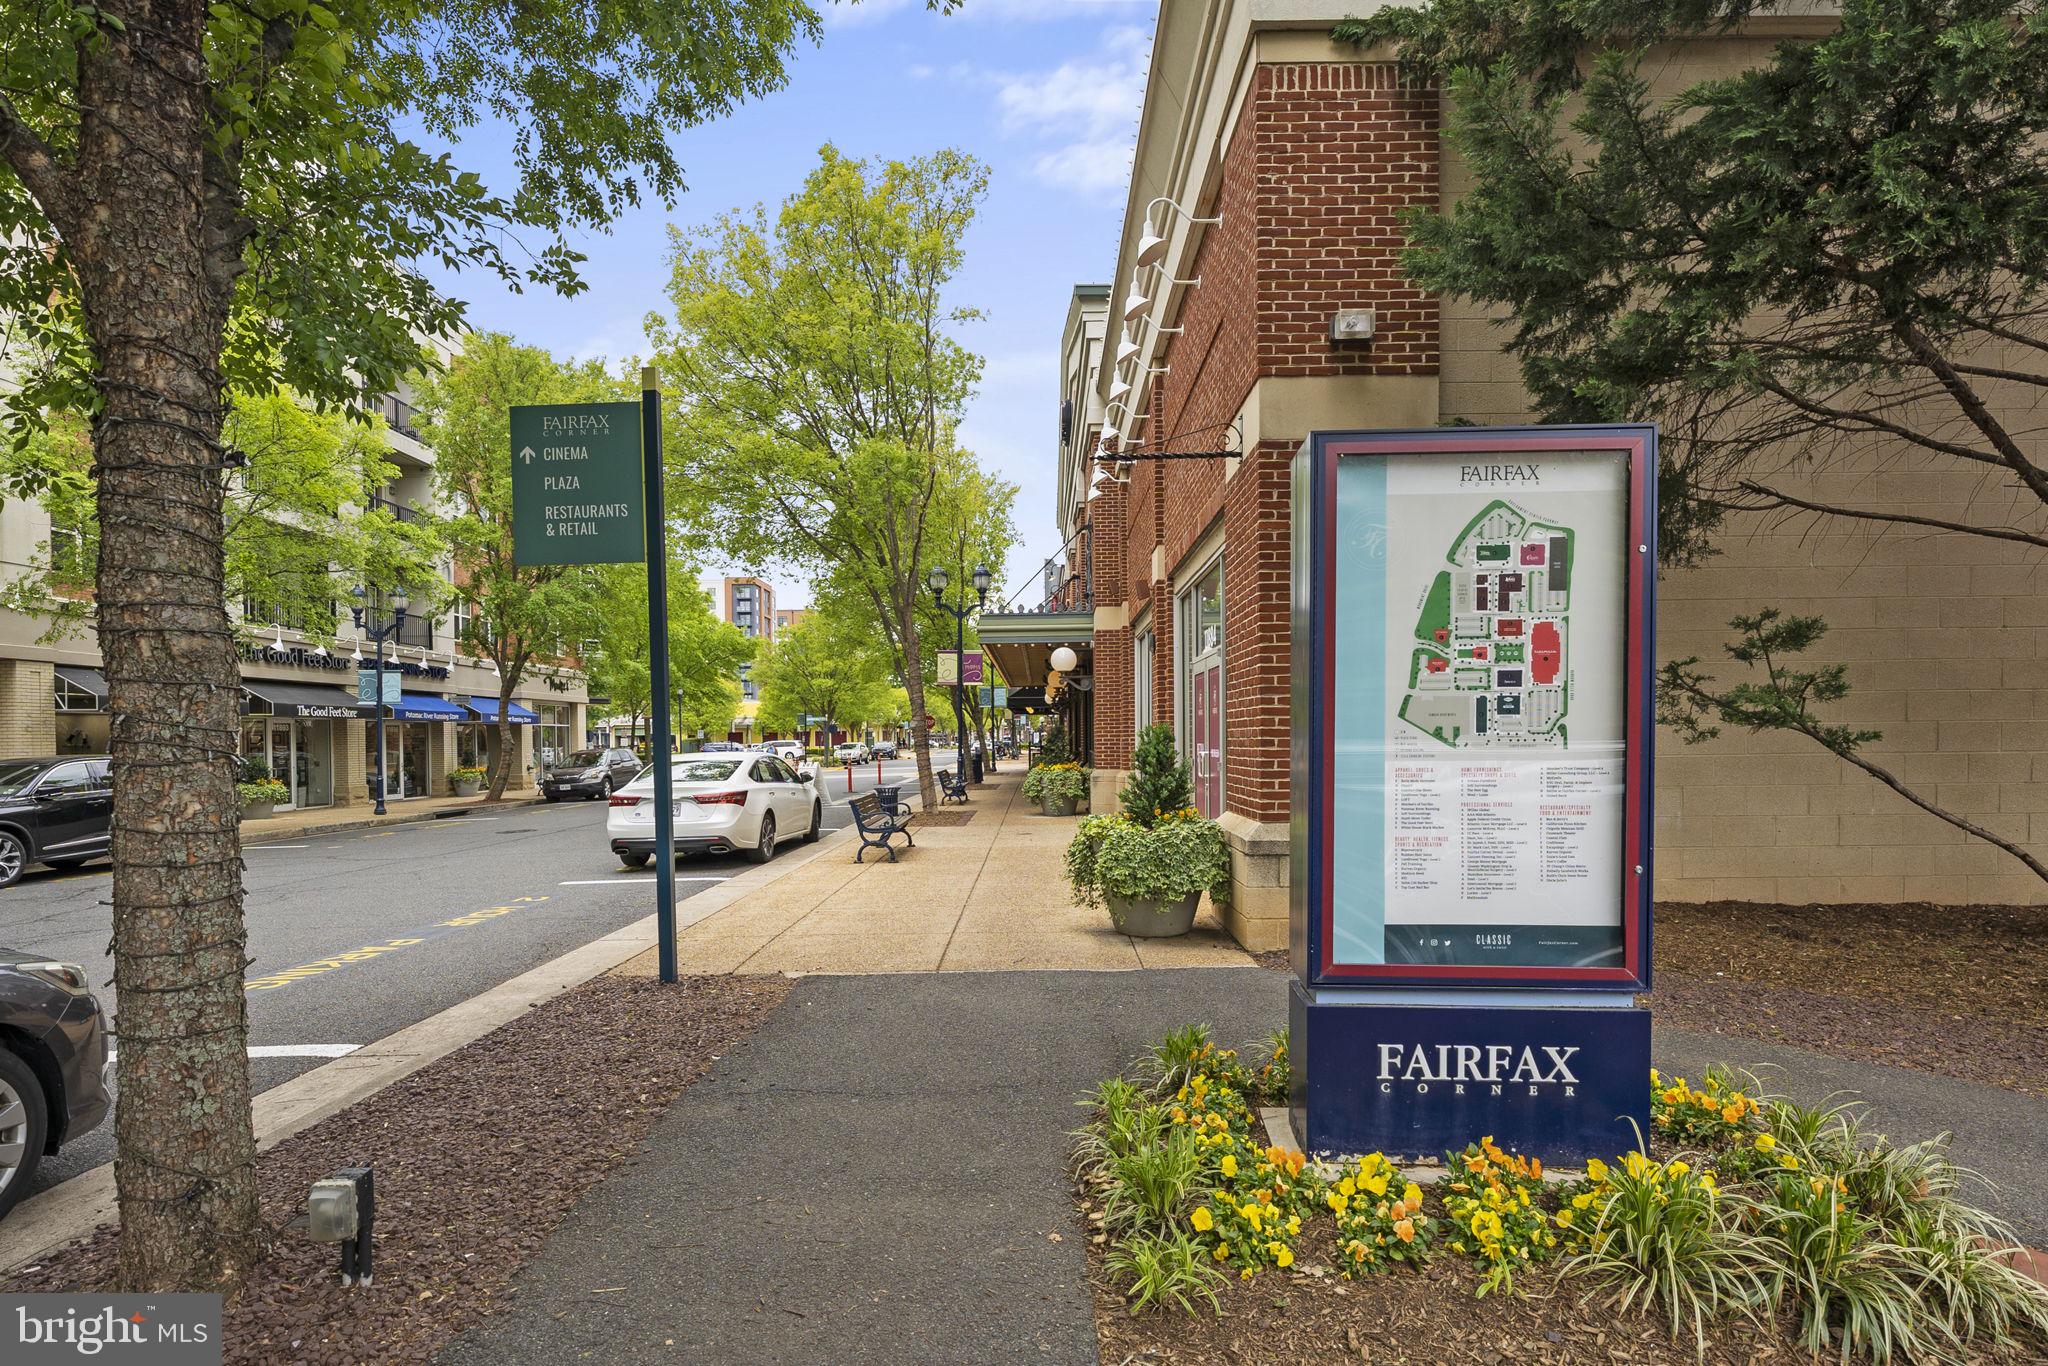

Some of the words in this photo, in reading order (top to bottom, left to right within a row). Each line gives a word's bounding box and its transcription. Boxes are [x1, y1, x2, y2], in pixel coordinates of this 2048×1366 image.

[544, 414, 610, 431] FAIRFAX
[542, 429, 610, 438] CORNER
[544, 446, 589, 461] CINEMA
[1460, 465, 1540, 481] FAIRFAX
[544, 476, 580, 490] PLAZA
[545, 503, 629, 520] RESTAURANTS
[546, 523, 556, 536] &
[559, 522, 599, 536] RETAIL
[243, 647, 264, 662] The
[267, 647, 299, 665] Good
[302, 651, 325, 668] Feet
[326, 653, 351, 670] Store
[297, 705, 310, 716] The
[311, 706, 328, 717] Good
[329, 707, 342, 717] Feet
[342, 707, 358, 718] Store
[405, 711, 424, 719] Potomac
[434, 713, 449, 721] Running
[1476, 934, 1512, 945] CLASSIC
[1377, 1043, 1580, 1083] FAIRFAX
[1381, 1083, 1576, 1097] CORNER
